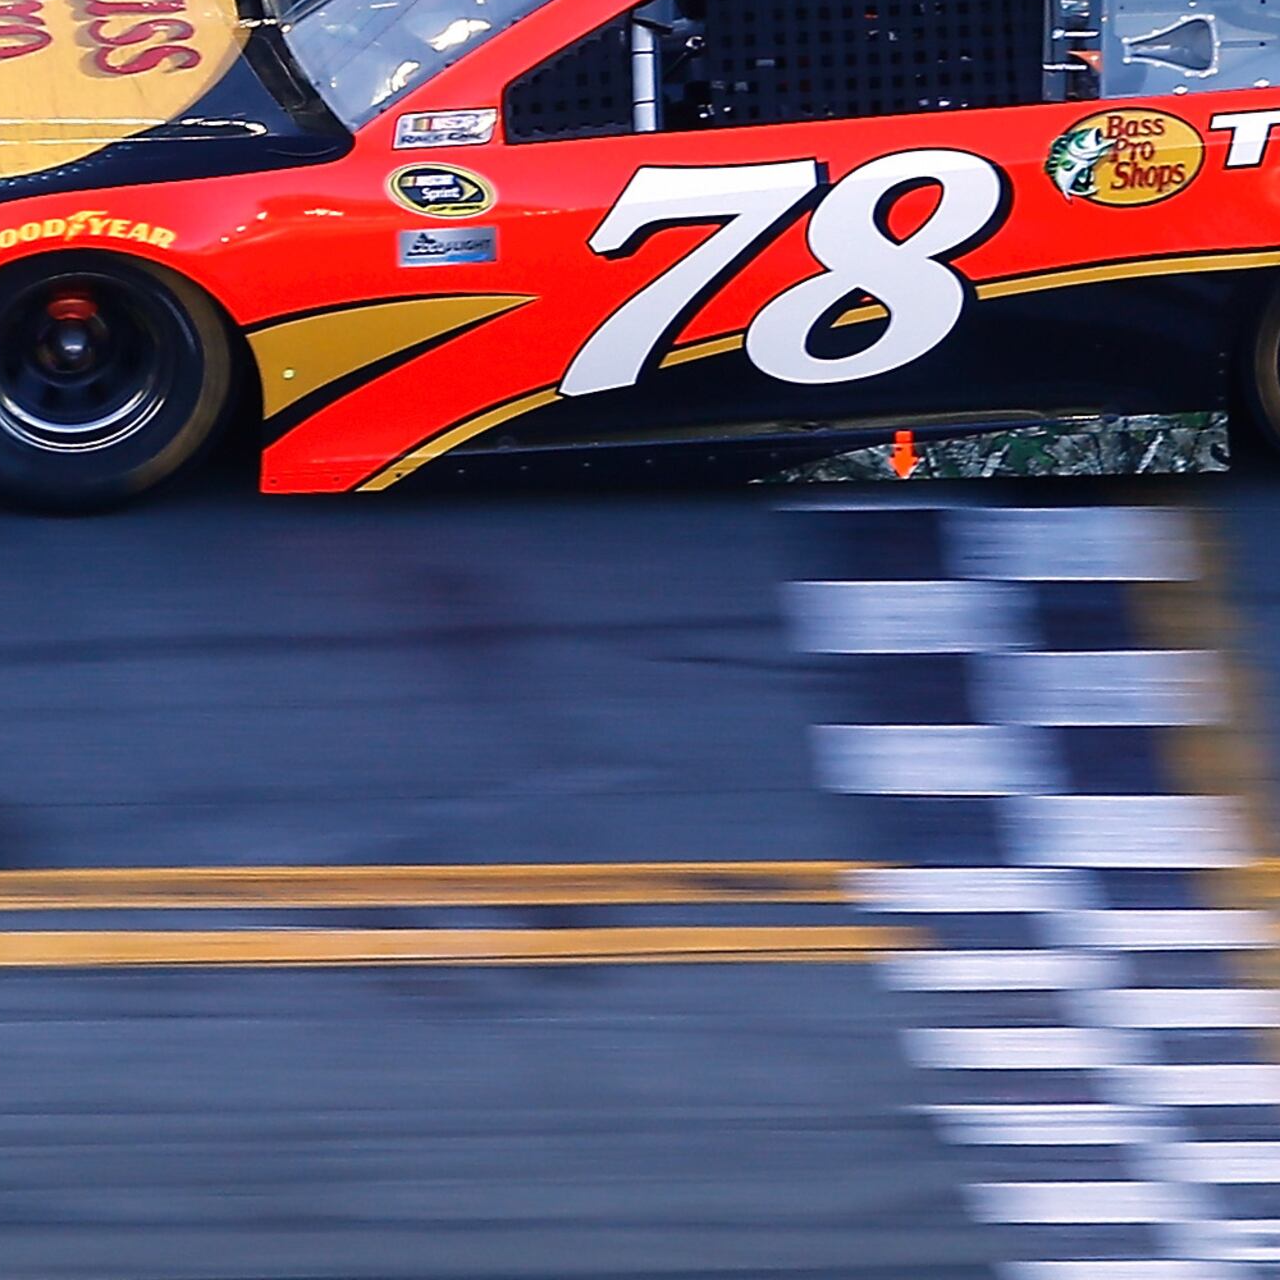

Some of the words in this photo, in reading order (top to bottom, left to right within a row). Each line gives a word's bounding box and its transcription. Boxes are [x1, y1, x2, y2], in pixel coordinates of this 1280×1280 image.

[1104, 114, 1166, 140] Bass
[1108, 136, 1155, 163] Pro
[1110, 161, 1186, 193] Shops
[421, 186, 462, 202] Sprint
[556, 147, 1003, 397] 78
